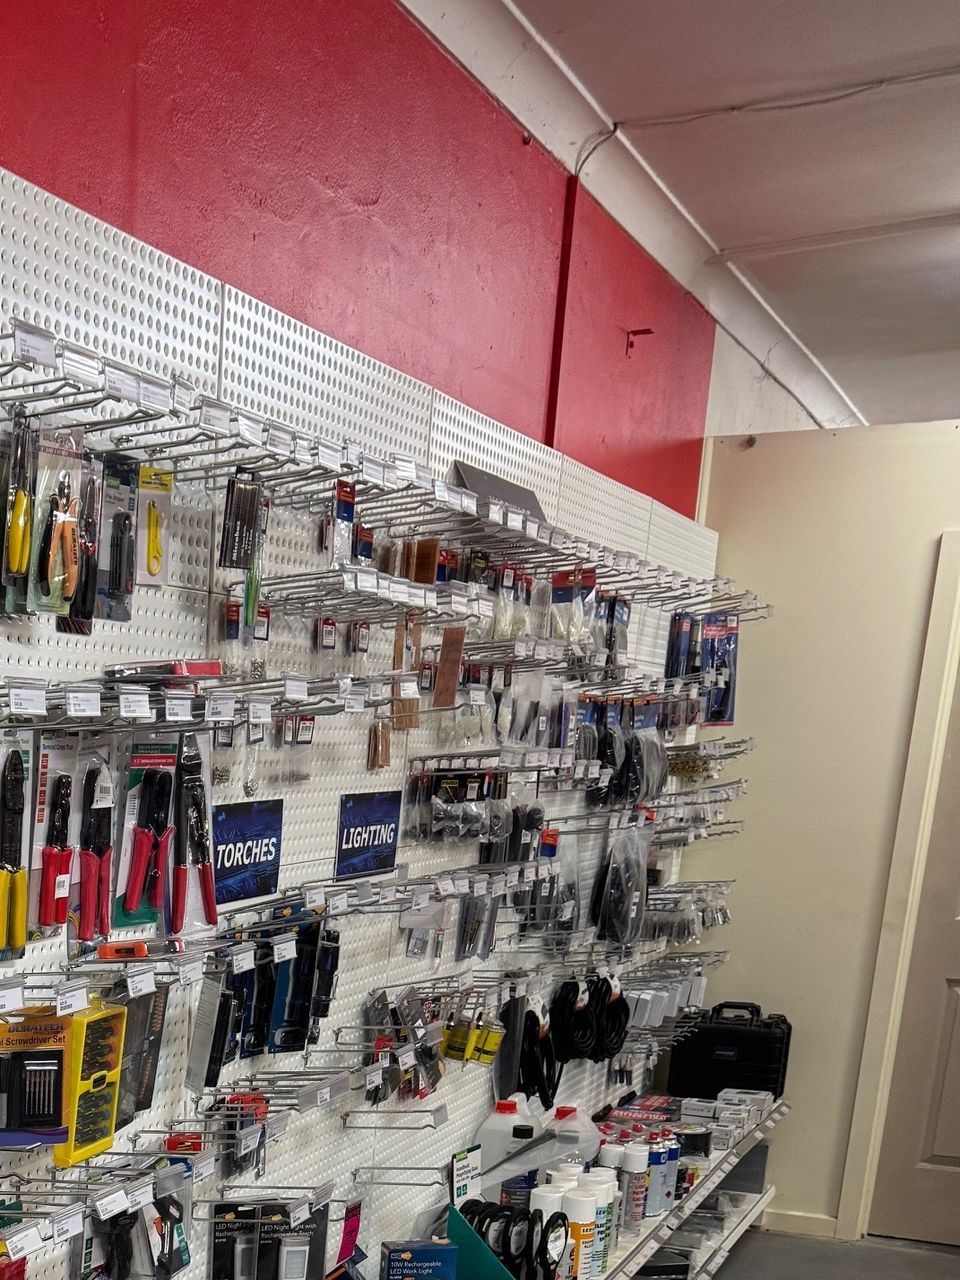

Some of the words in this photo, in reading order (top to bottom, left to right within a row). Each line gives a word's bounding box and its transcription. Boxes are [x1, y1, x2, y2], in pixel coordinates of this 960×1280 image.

[342, 823, 395, 850] LIGHTING
[216, 837, 277, 870] TORCHES
[5, 1036, 51, 1046] Screwdriver
[52, 1034, 66, 1044] Set
[403, 1260, 442, 1269] Rechargeable
[418, 1267, 433, 1276] Light
